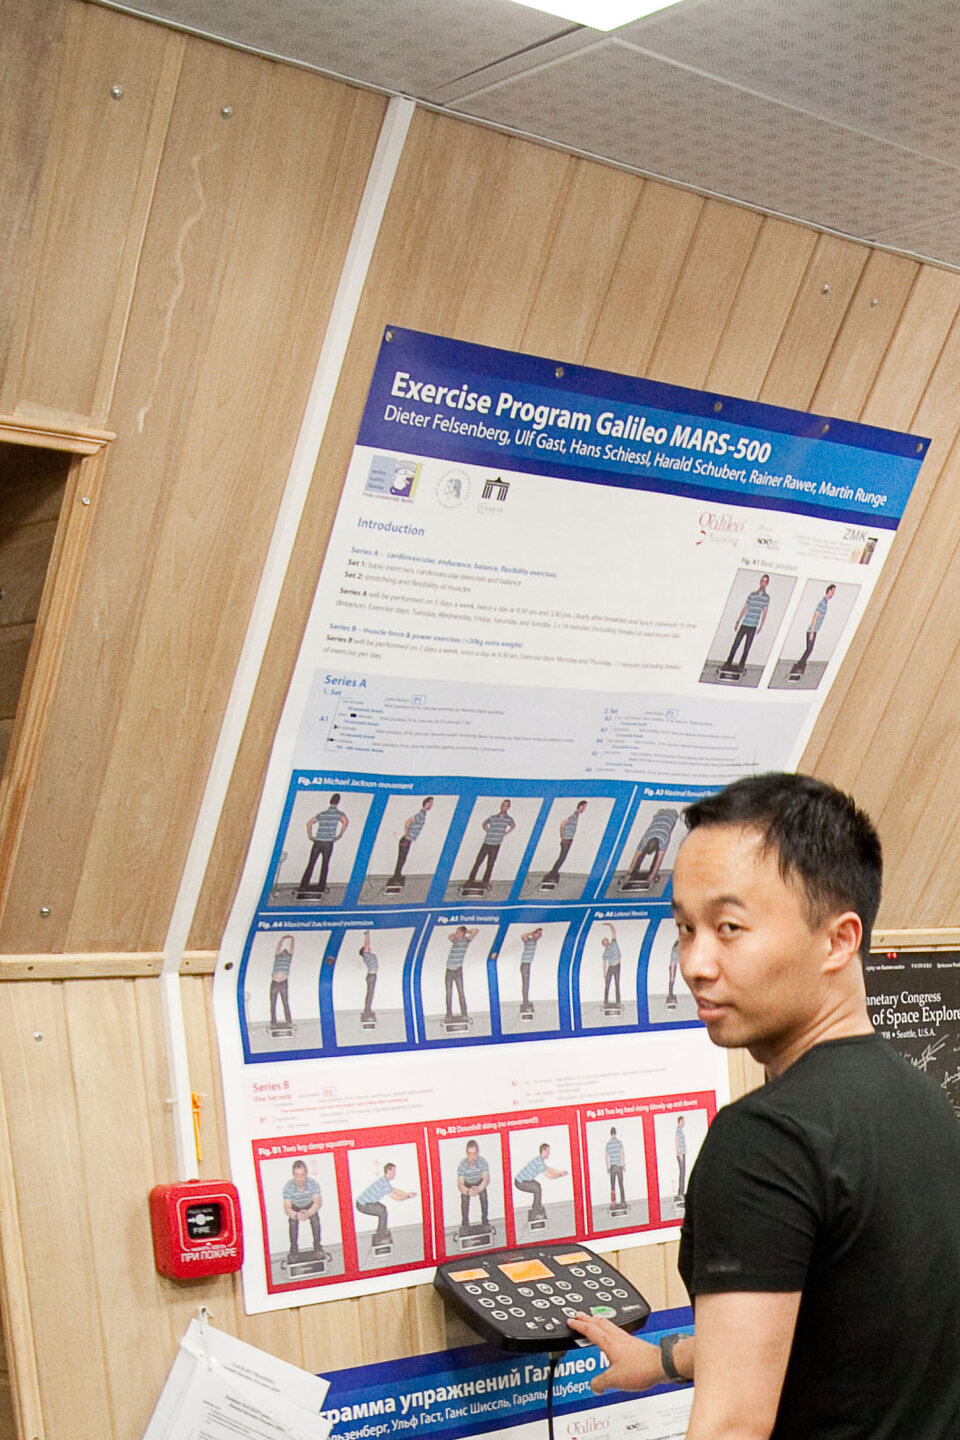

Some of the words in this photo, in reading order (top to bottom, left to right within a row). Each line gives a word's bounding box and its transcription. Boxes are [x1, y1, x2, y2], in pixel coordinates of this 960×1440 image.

[390, 371, 492, 413] Exercise
[496, 392, 591, 431] Program
[595, 411, 668, 446] Galileo
[669, 424, 772, 464] MARS-500
[383, 404, 430, 428] Dieter
[433, 413, 510, 446] Felsenberg,
[515, 428, 534, 447] Ulf
[535, 433, 567, 455] Gast,
[569, 438, 602, 459] Hans
[603, 443, 652, 468] Schiessl,
[653, 453, 693, 471] Harald
[693, 458, 747, 484] Schubert,
[749, 469, 783, 488] Rainer
[783, 475, 817, 495] Rawer,
[818, 481, 853, 500] Martin
[854, 489, 888, 508] Runge
[357, 517, 425, 537] Introduction
[842, 528, 868, 543] ZMK
[351, 546, 372, 556] Series
[347, 558, 357, 567] Set
[344, 570, 356, 579] Set
[339, 587, 361, 597] Series
[329, 622, 351, 633] Series
[412, 632, 433, 642] power
[325, 634, 348, 644] Series
[324, 674, 357, 688] Series
[359, 678, 367, 689] A
[298, 777, 311, 786] Fig.
[323, 777, 350, 787] Michael
[350, 779, 378, 789] Jackson
[378, 782, 414, 790] movement
[643, 788, 655, 797] Fig.
[437, 915, 450, 924] Fig.
[613, 910, 631, 918] Lateral
[258, 921, 271, 930] Fig.
[283, 920, 310, 928] Maximal
[865, 993, 898, 1009] anetary
[900, 990, 942, 1008] Congress
[872, 1009, 886, 1026] of
[886, 1010, 920, 1029] Space
[253, 1082, 282, 1093] Series
[283, 1080, 290, 1090] B
[586, 1110, 597, 1119] Fig.
[616, 1107, 624, 1116] leg
[436, 1127, 448, 1136] Fig.
[456, 1122, 482, 1133] Downhill
[258, 1147, 271, 1157] Fig.
[297, 1144, 308, 1153] leg
[193, 1226, 211, 1234] FIRE
[181, 1252, 200, 1263] ПРИ
[200, 1247, 237, 1260] ПОЖАРЕ
[320, 1397, 396, 1425] грамма
[399, 1368, 521, 1415] упражнений
[525, 1356, 597, 1384] Галилео
[391, 1415, 418, 1432] Ульф
[420, 1410, 444, 1426] Гаст,
[445, 1405, 468, 1420] Ганс
[470, 1398, 512, 1415] Шиссль,
[513, 1389, 549, 1406] Гараль
